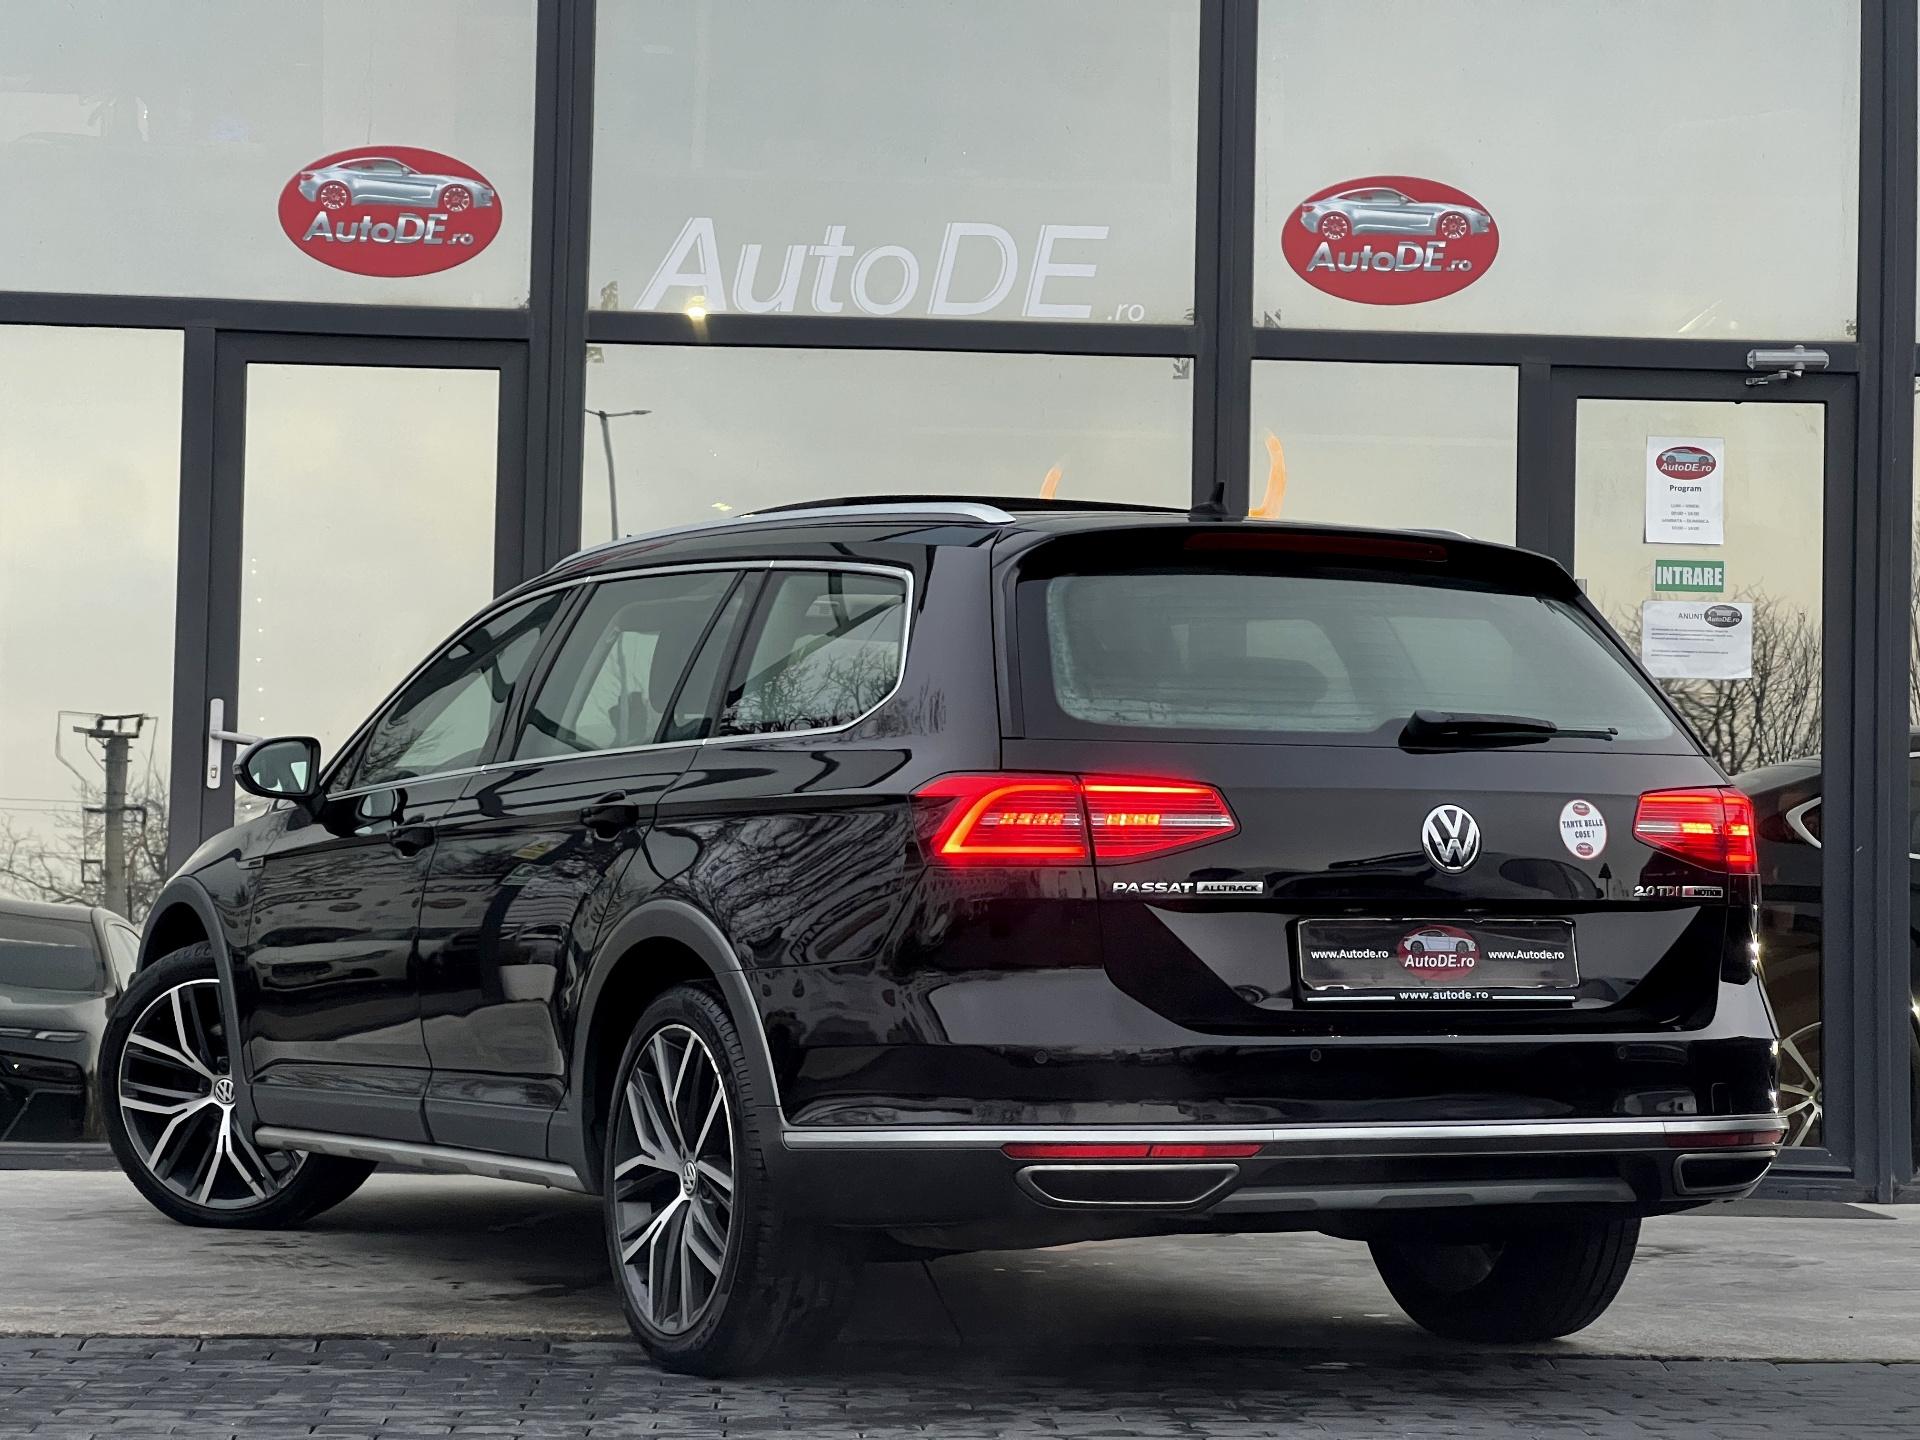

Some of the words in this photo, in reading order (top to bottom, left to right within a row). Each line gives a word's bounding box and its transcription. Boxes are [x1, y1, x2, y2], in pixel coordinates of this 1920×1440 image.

[1660, 462, 1712, 472] AutoDE.ro
[1669, 484, 1702, 493] Program
[1656, 566, 1723, 586] INTRARE
[1584, 819, 1603, 827] BELLE
[1575, 831, 1591, 839] COSE
[1112, 882, 1194, 894] PASSAT
[1202, 884, 1258, 892] ALLTRACK
[1656, 885, 1680, 897] TDI
[1310, 949, 1389, 960] www.Autode.ro
[1487, 949, 1565, 960] www.Autode.ro
[1404, 954, 1476, 969] AutoDE.ro
[1399, 990, 1489, 1000] www.autode.ro
